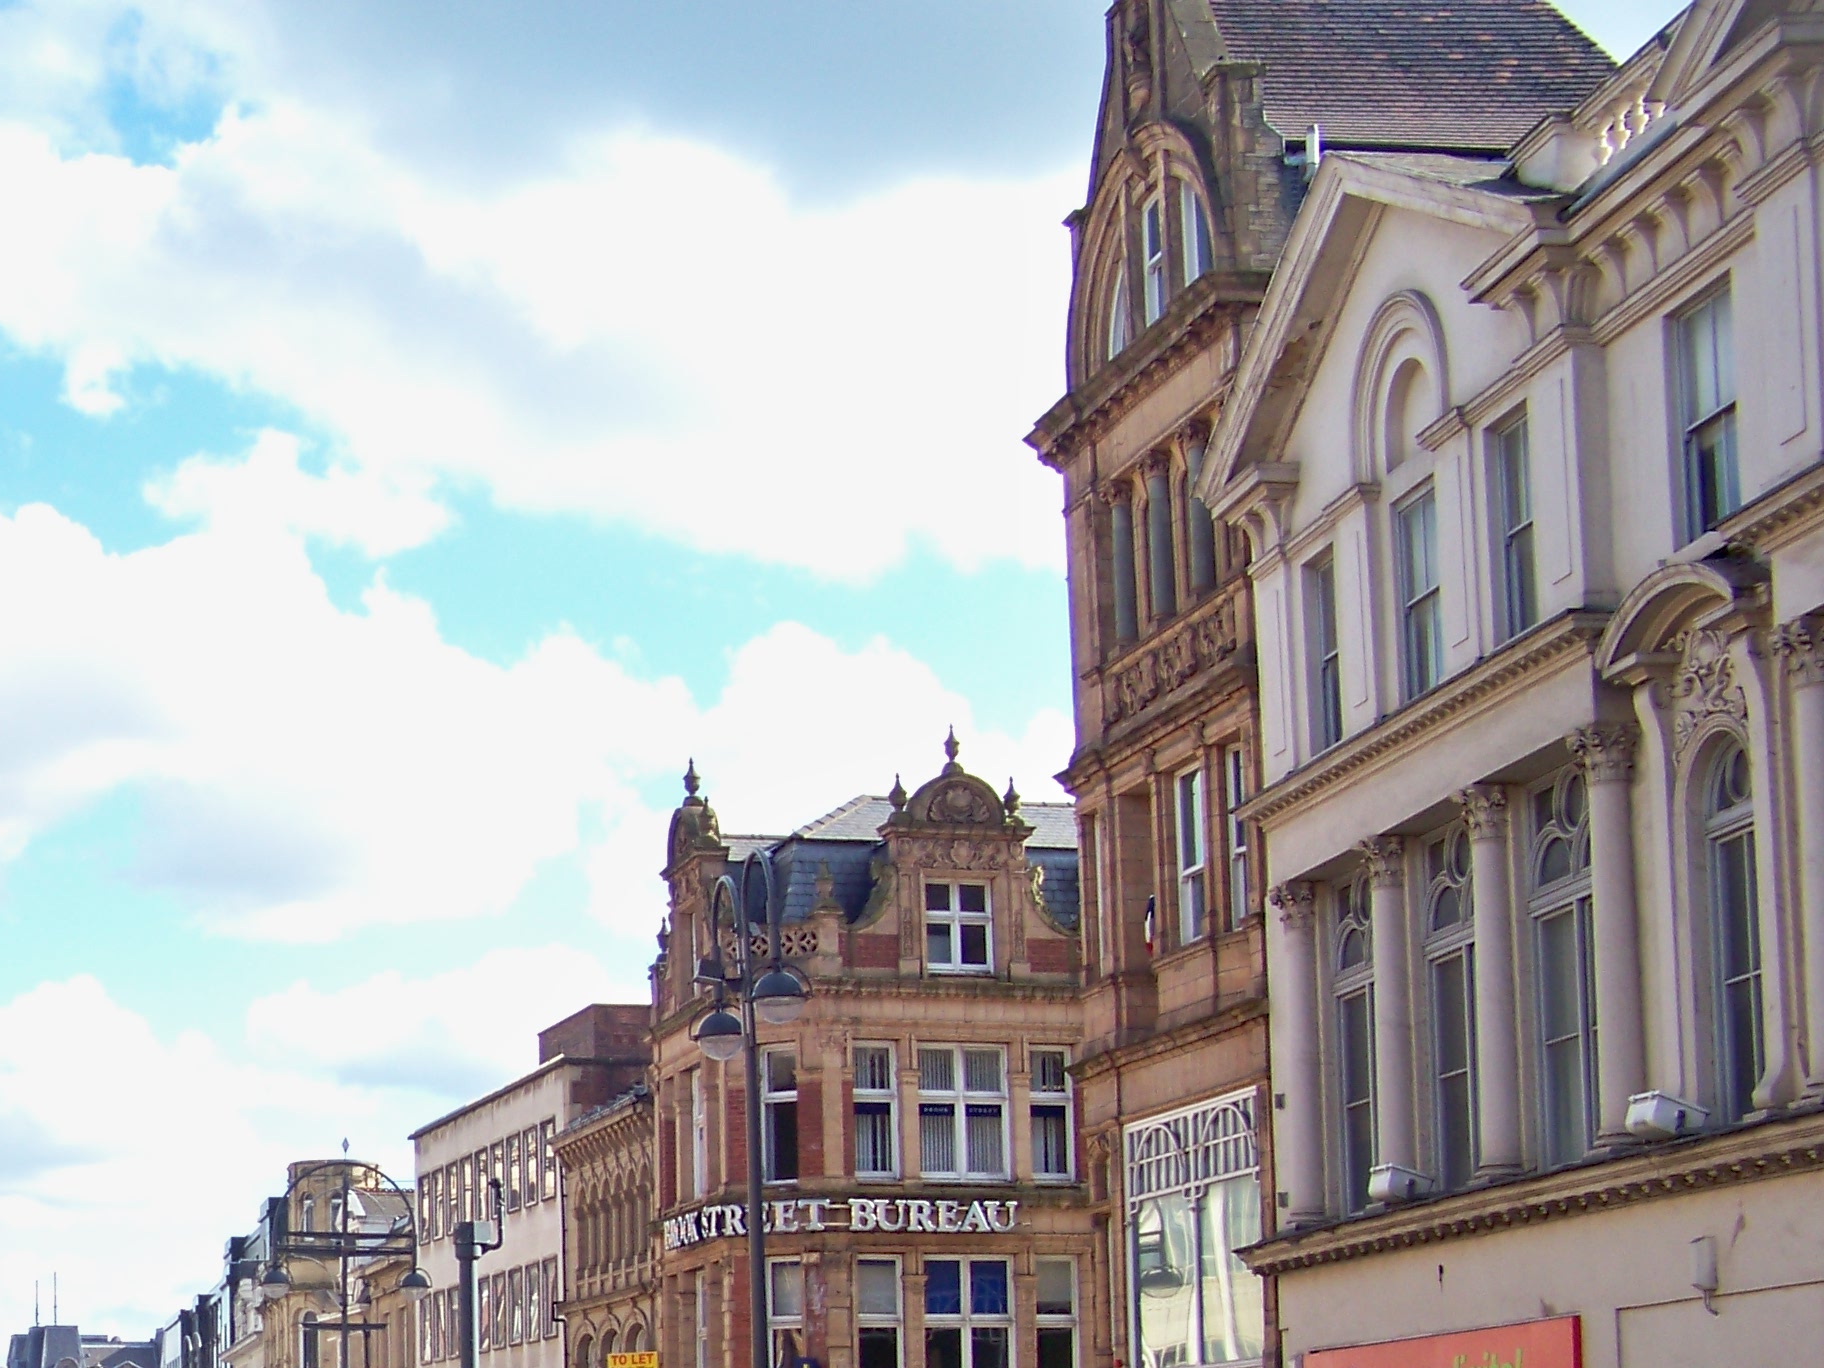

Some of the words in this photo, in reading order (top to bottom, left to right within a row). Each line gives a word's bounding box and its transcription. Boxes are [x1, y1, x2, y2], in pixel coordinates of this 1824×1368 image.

[848, 1198, 1018, 1233] BUREAU
[611, 1355, 627, 1366] TO
[631, 1353, 654, 1365] LET
